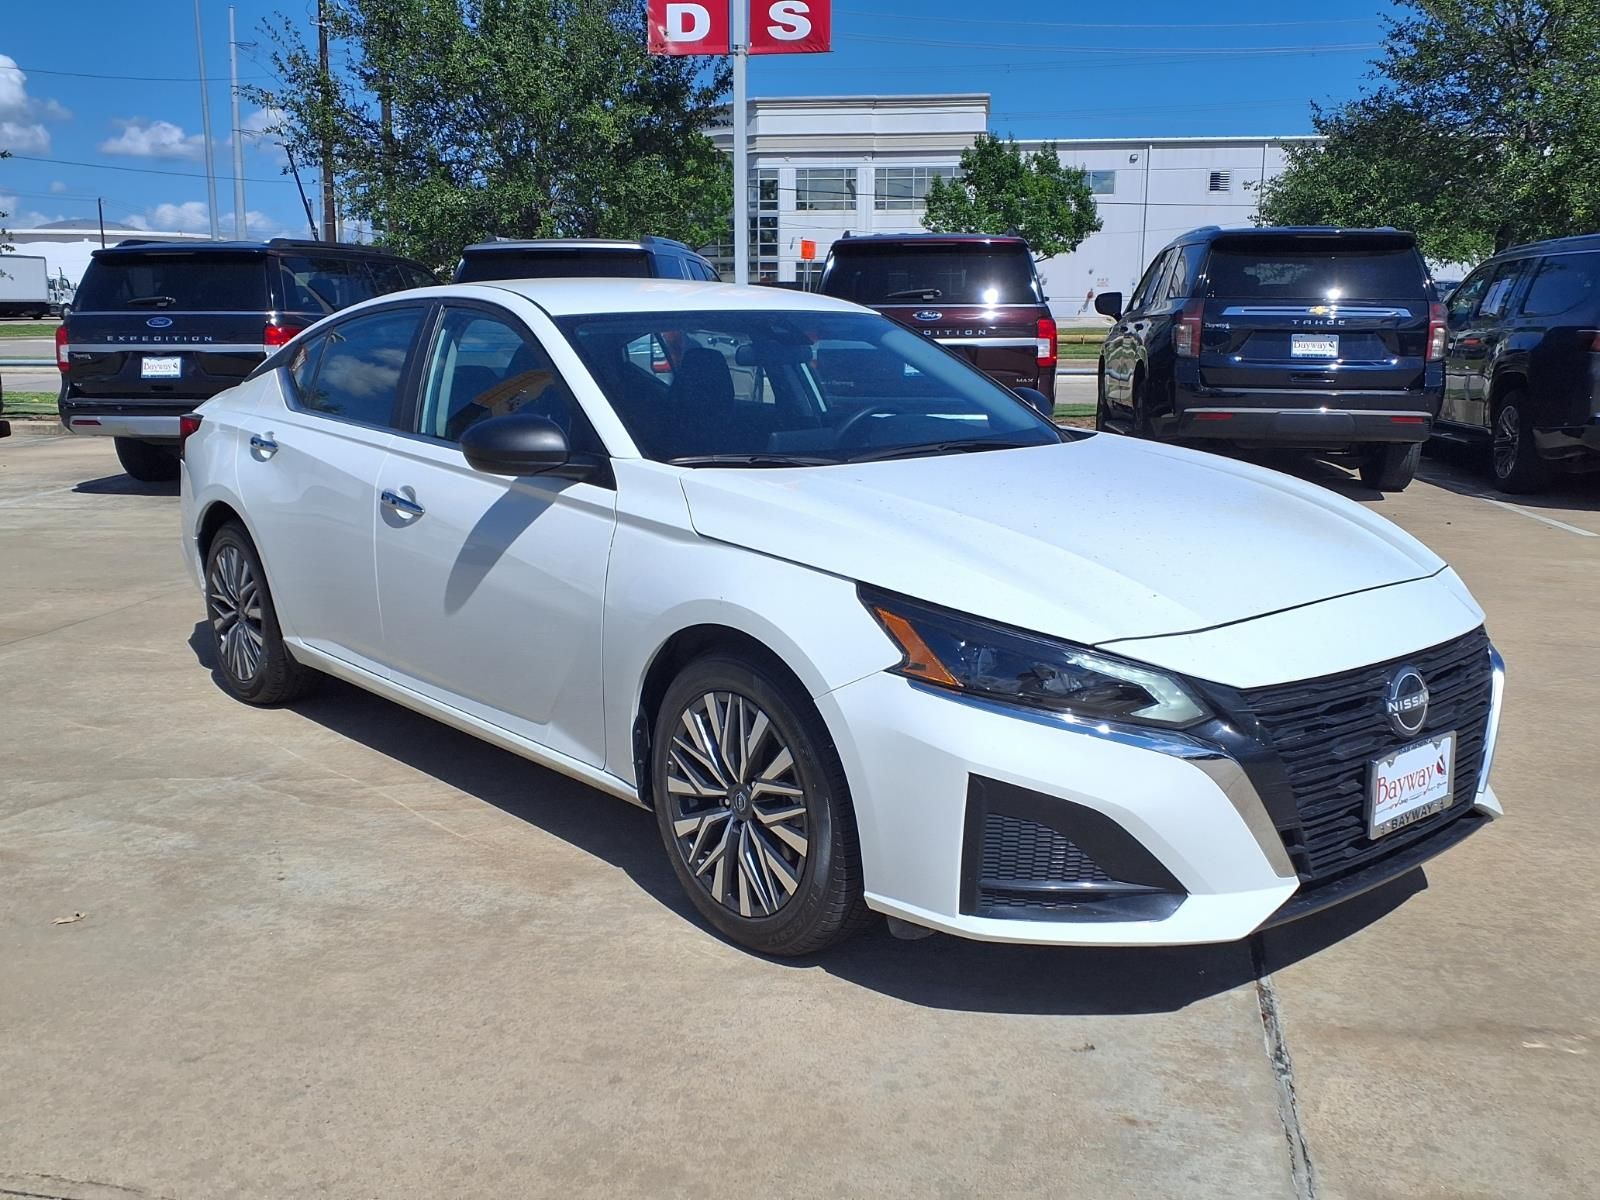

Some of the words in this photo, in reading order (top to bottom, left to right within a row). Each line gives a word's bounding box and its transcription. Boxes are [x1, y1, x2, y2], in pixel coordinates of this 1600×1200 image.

[666, 3, 711, 42] D
[767, 0, 812, 41] S
[1388, 690, 1430, 713] NISSAN
[1375, 763, 1435, 807] Bayway
[1391, 803, 1434, 830] BAYWAY
